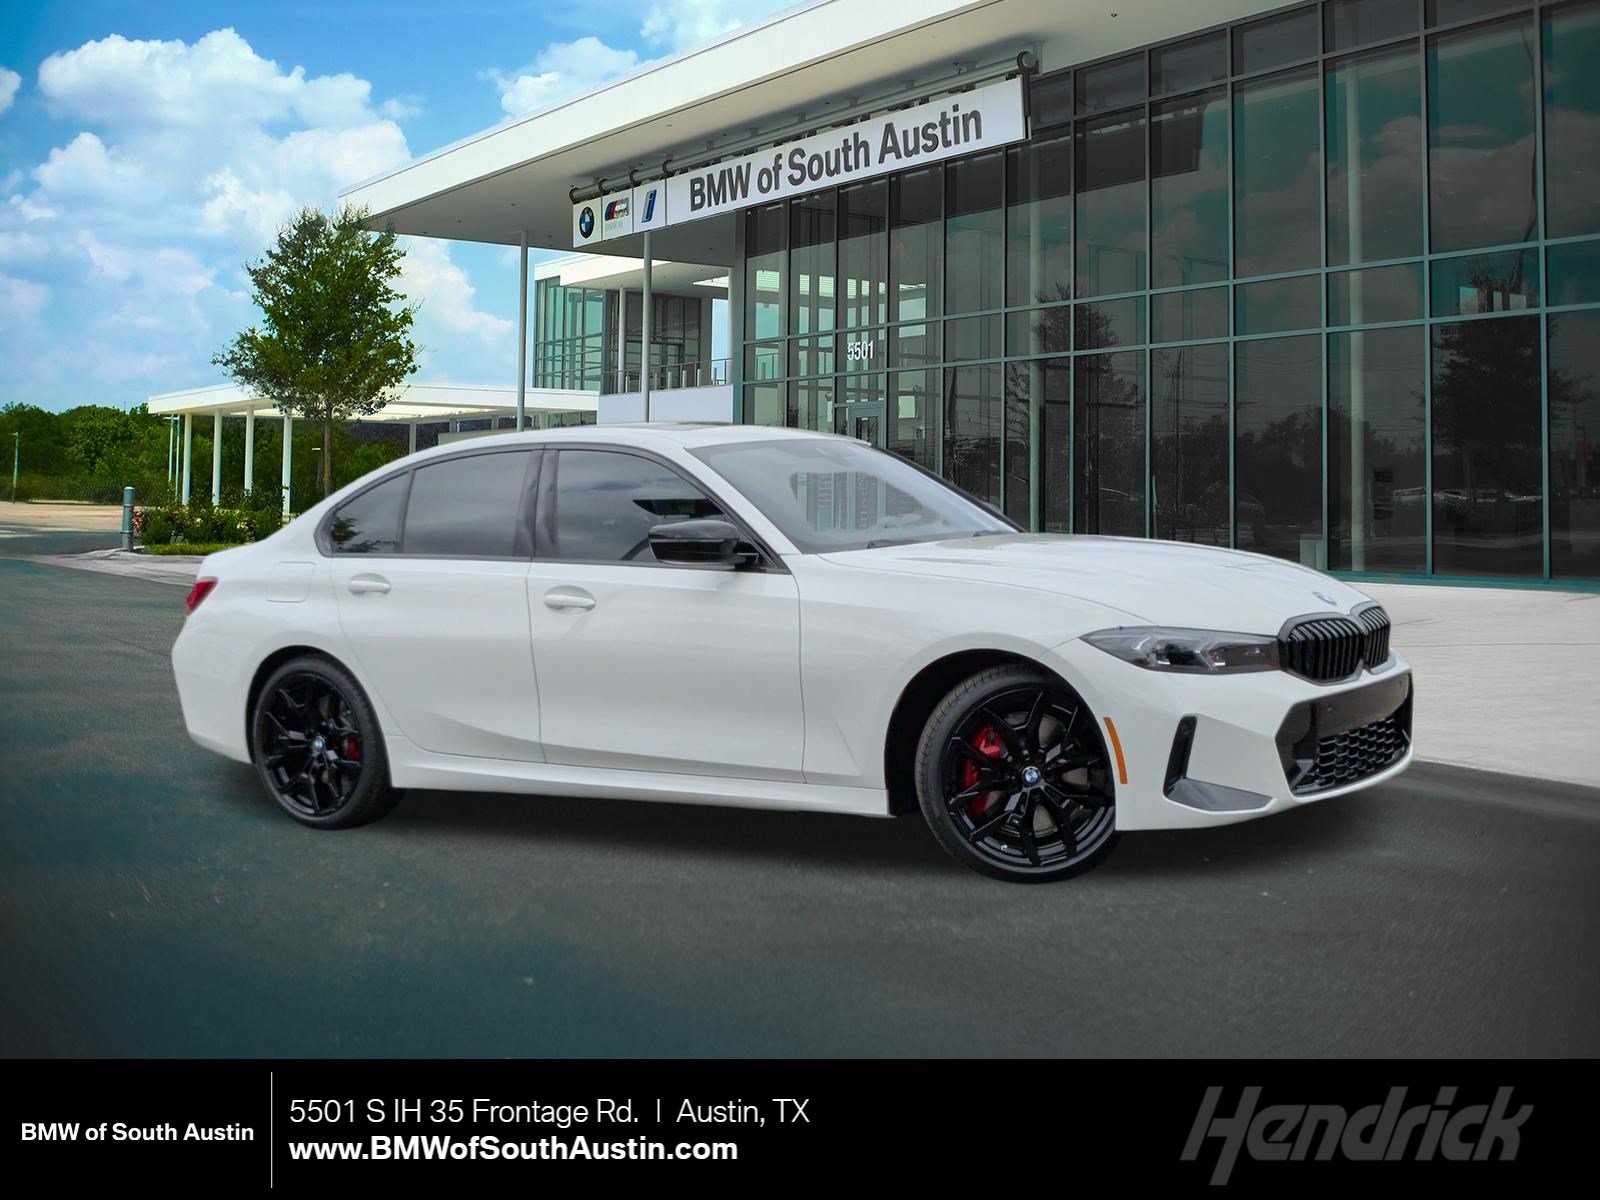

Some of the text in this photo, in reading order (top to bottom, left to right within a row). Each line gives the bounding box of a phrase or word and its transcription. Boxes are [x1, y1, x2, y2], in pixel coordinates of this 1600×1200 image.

[690, 162, 751, 212] BMW
[757, 153, 783, 194] of
[787, 131, 870, 187] South
[878, 104, 983, 164] Austin
[847, 340, 874, 361] 5501
